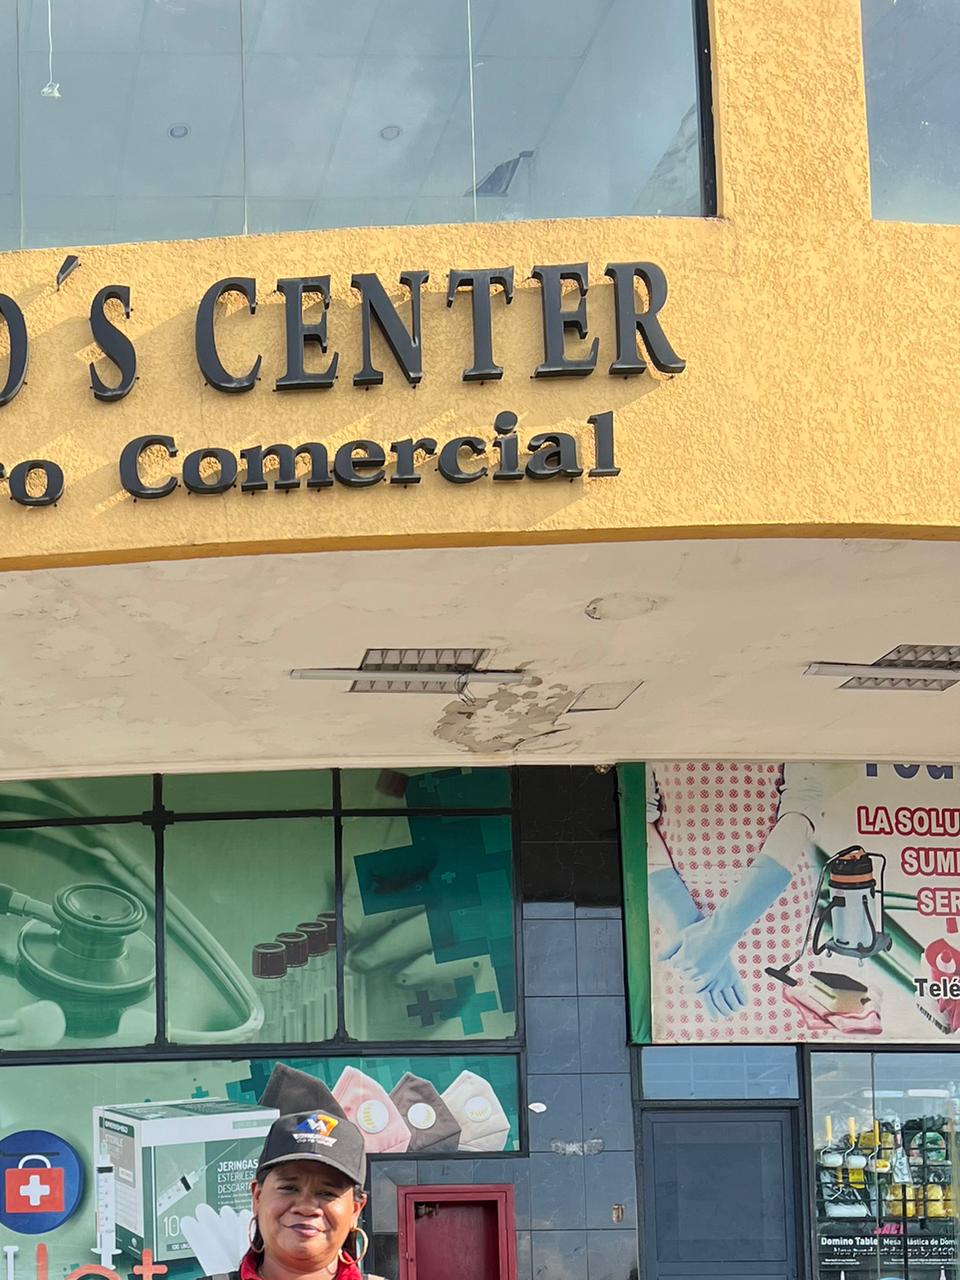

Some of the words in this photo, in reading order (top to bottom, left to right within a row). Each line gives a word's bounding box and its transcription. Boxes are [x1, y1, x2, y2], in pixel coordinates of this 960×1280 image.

[195, 261, 686, 393] CENTER
[120, 412, 619, 503] Comercial
[857, 805, 893, 835] LA
[895, 806, 960, 836] SOLU
[217, 1159, 259, 1172] JERINGAS
[217, 1182, 252, 1194] DESCART
[821, 1236, 854, 1246] Domino
[854, 1236, 878, 1246] Table
[883, 1237, 901, 1246] Mesa
